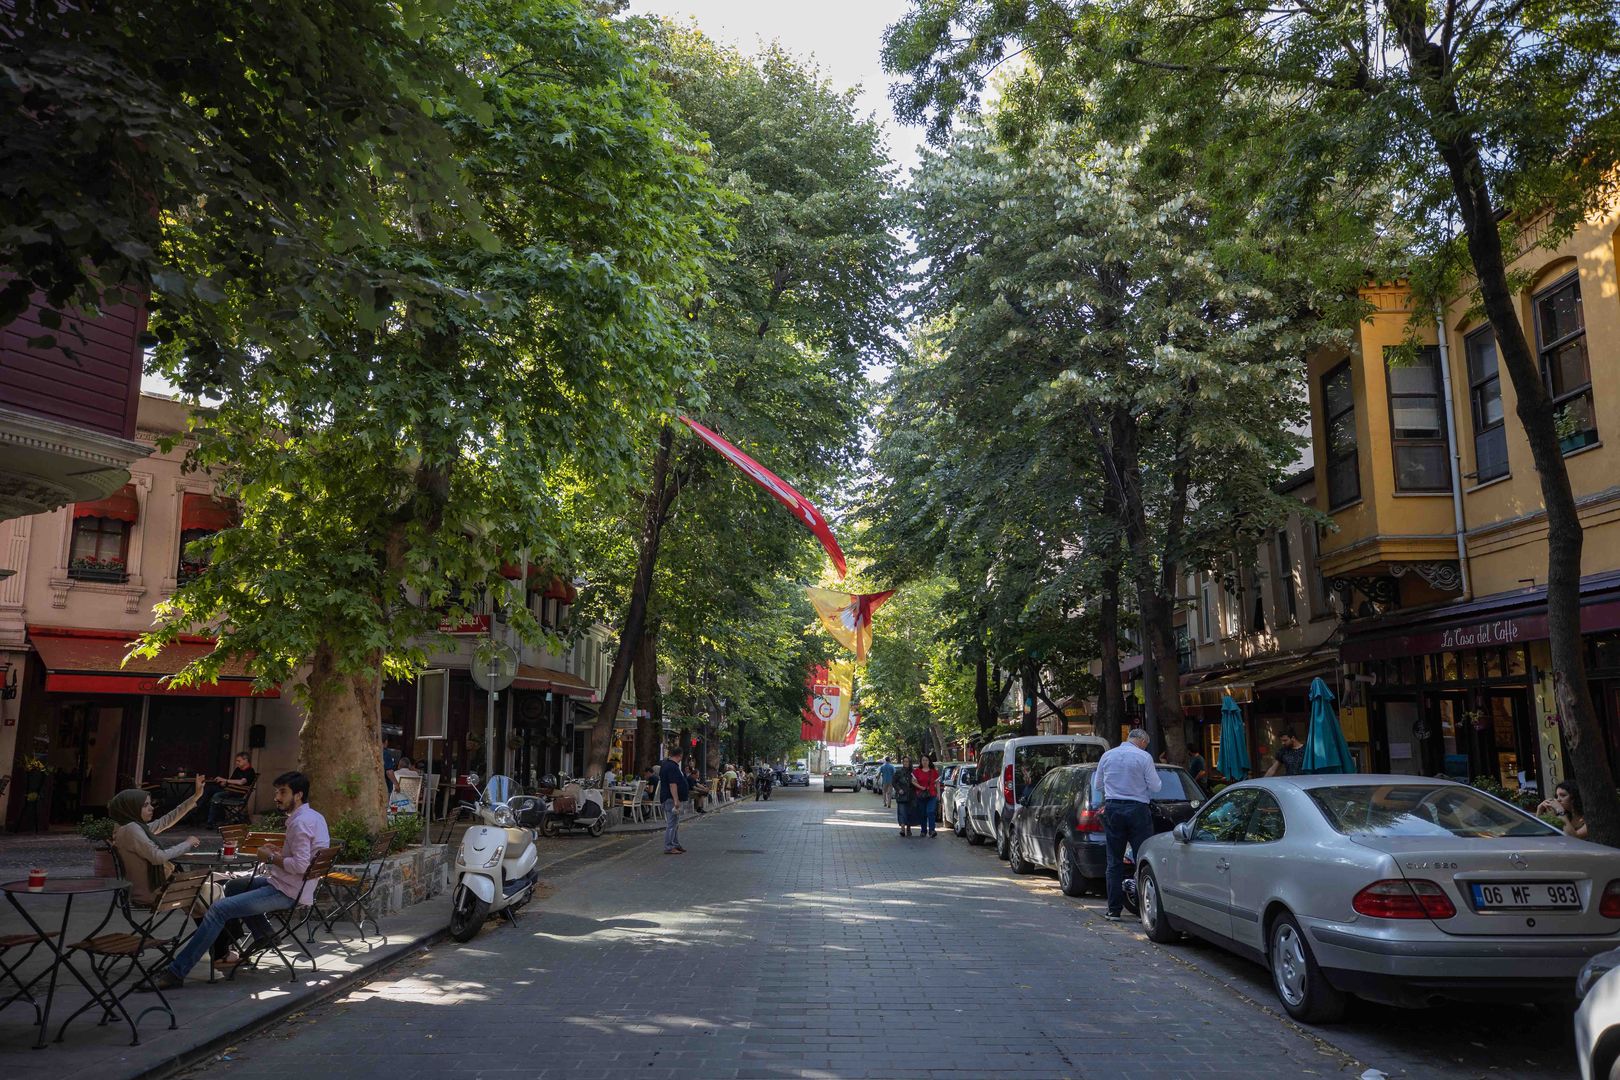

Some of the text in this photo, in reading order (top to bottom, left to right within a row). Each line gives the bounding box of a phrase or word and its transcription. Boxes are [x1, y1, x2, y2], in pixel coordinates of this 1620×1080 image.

[1441, 620, 1518, 647] La Casa del Caffè
[1483, 886, 1577, 904] 06 MF 983
